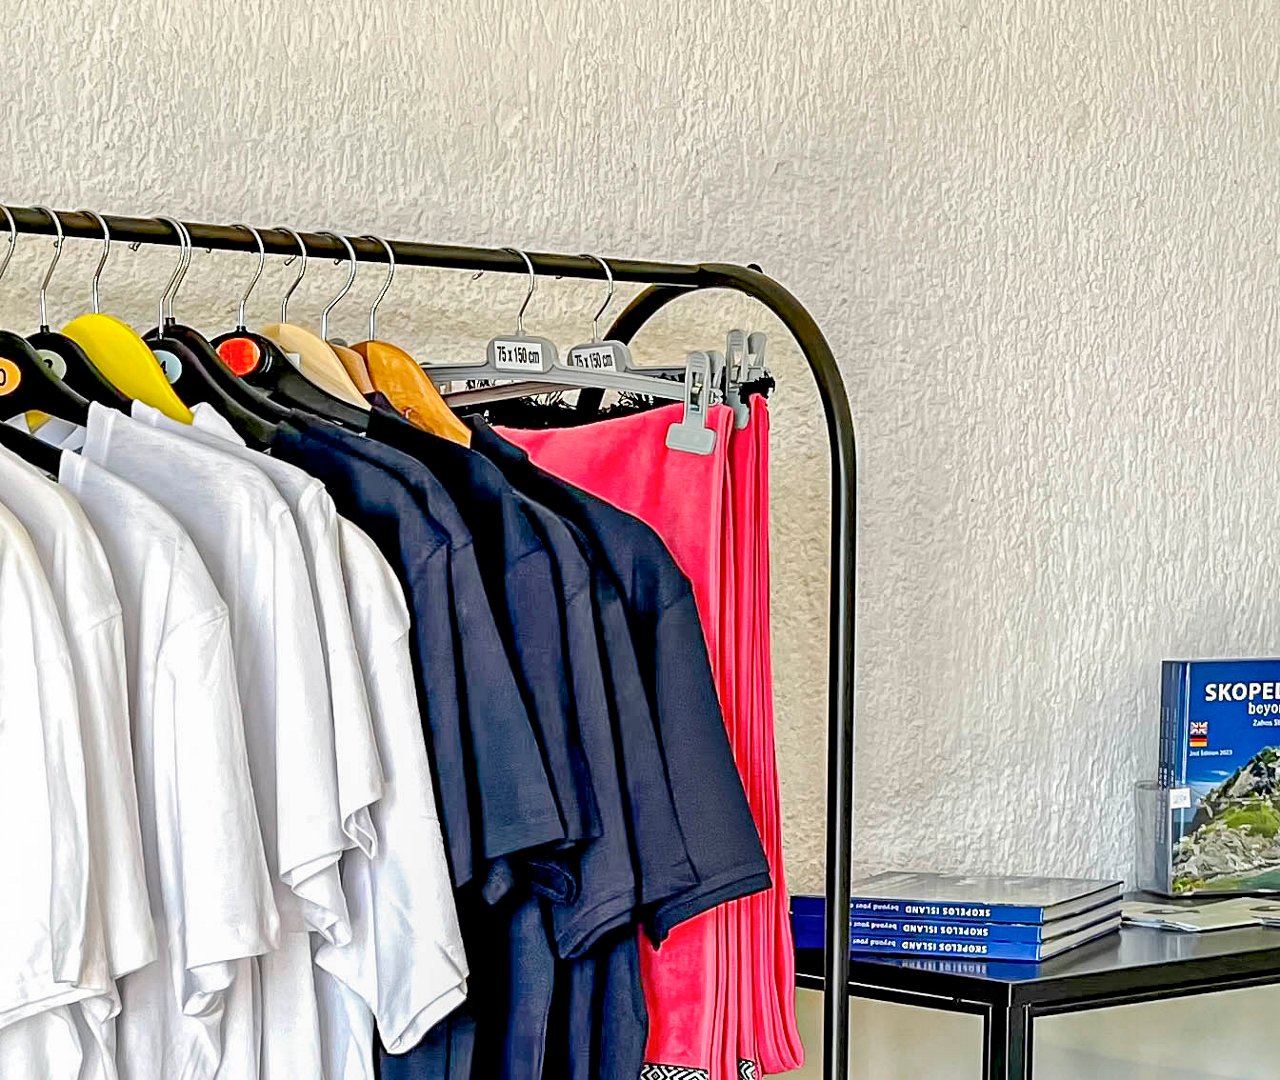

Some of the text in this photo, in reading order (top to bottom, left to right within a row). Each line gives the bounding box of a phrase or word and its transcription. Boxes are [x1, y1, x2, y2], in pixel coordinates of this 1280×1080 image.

[497, 346, 507, 362] 75
[514, 347, 527, 363] 150
[528, 351, 539, 364] cm
[589, 352, 602, 368] 150
[905, 905, 939, 915] ISLAND
[943, 907, 991, 917] SKOPELOS
[903, 924, 938, 934] ISLAND
[940, 926, 989, 936] SKOPELOS
[901, 941, 937, 952] ISLAND
[938, 943, 988, 954] SKOPELOS
